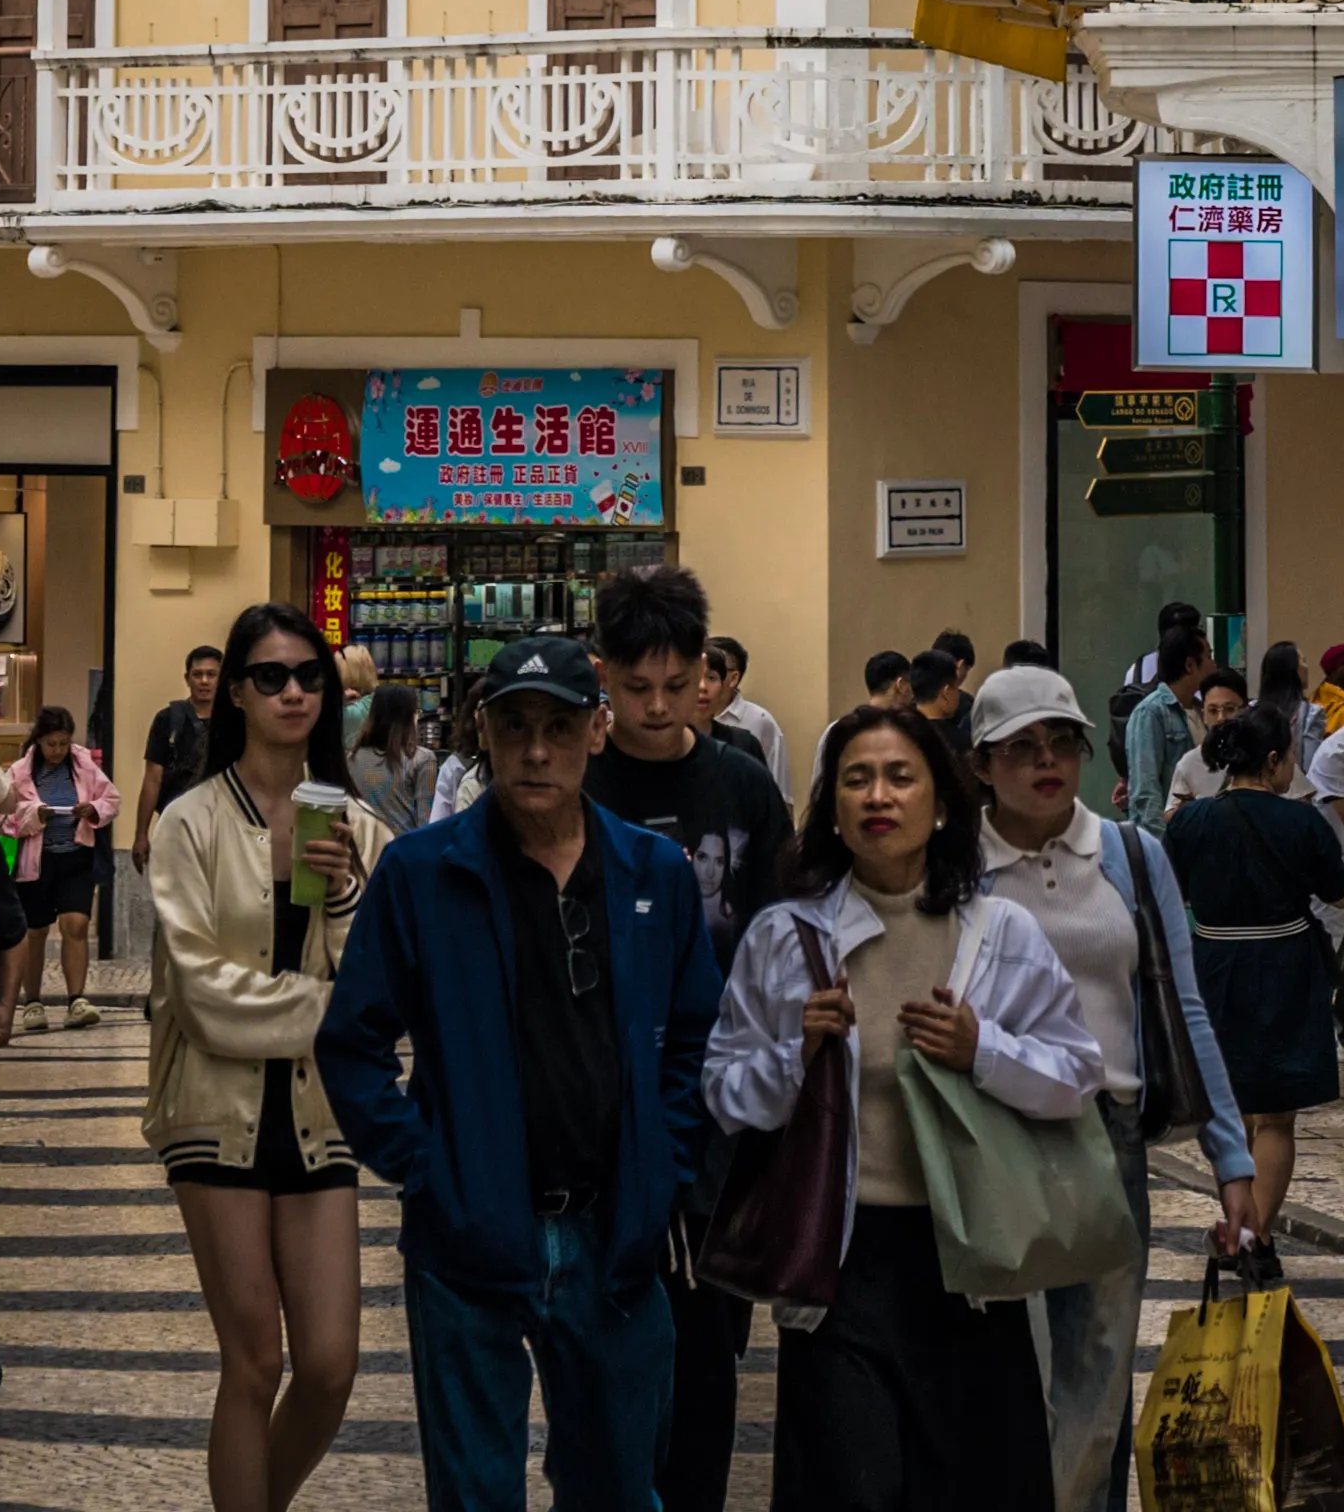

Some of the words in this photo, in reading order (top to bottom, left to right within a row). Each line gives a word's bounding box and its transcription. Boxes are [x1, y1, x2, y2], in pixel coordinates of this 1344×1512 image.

[1167, 172, 1285, 203] 政府註冊
[1167, 204, 1285, 235] 仁濟藥房
[743, 392, 754, 402] DE
[404, 402, 618, 458] 運通生活館
[622, 441, 649, 454] XVIII
[438, 463, 505, 486] 政府註冊
[513, 463, 579, 486] 正品正貨
